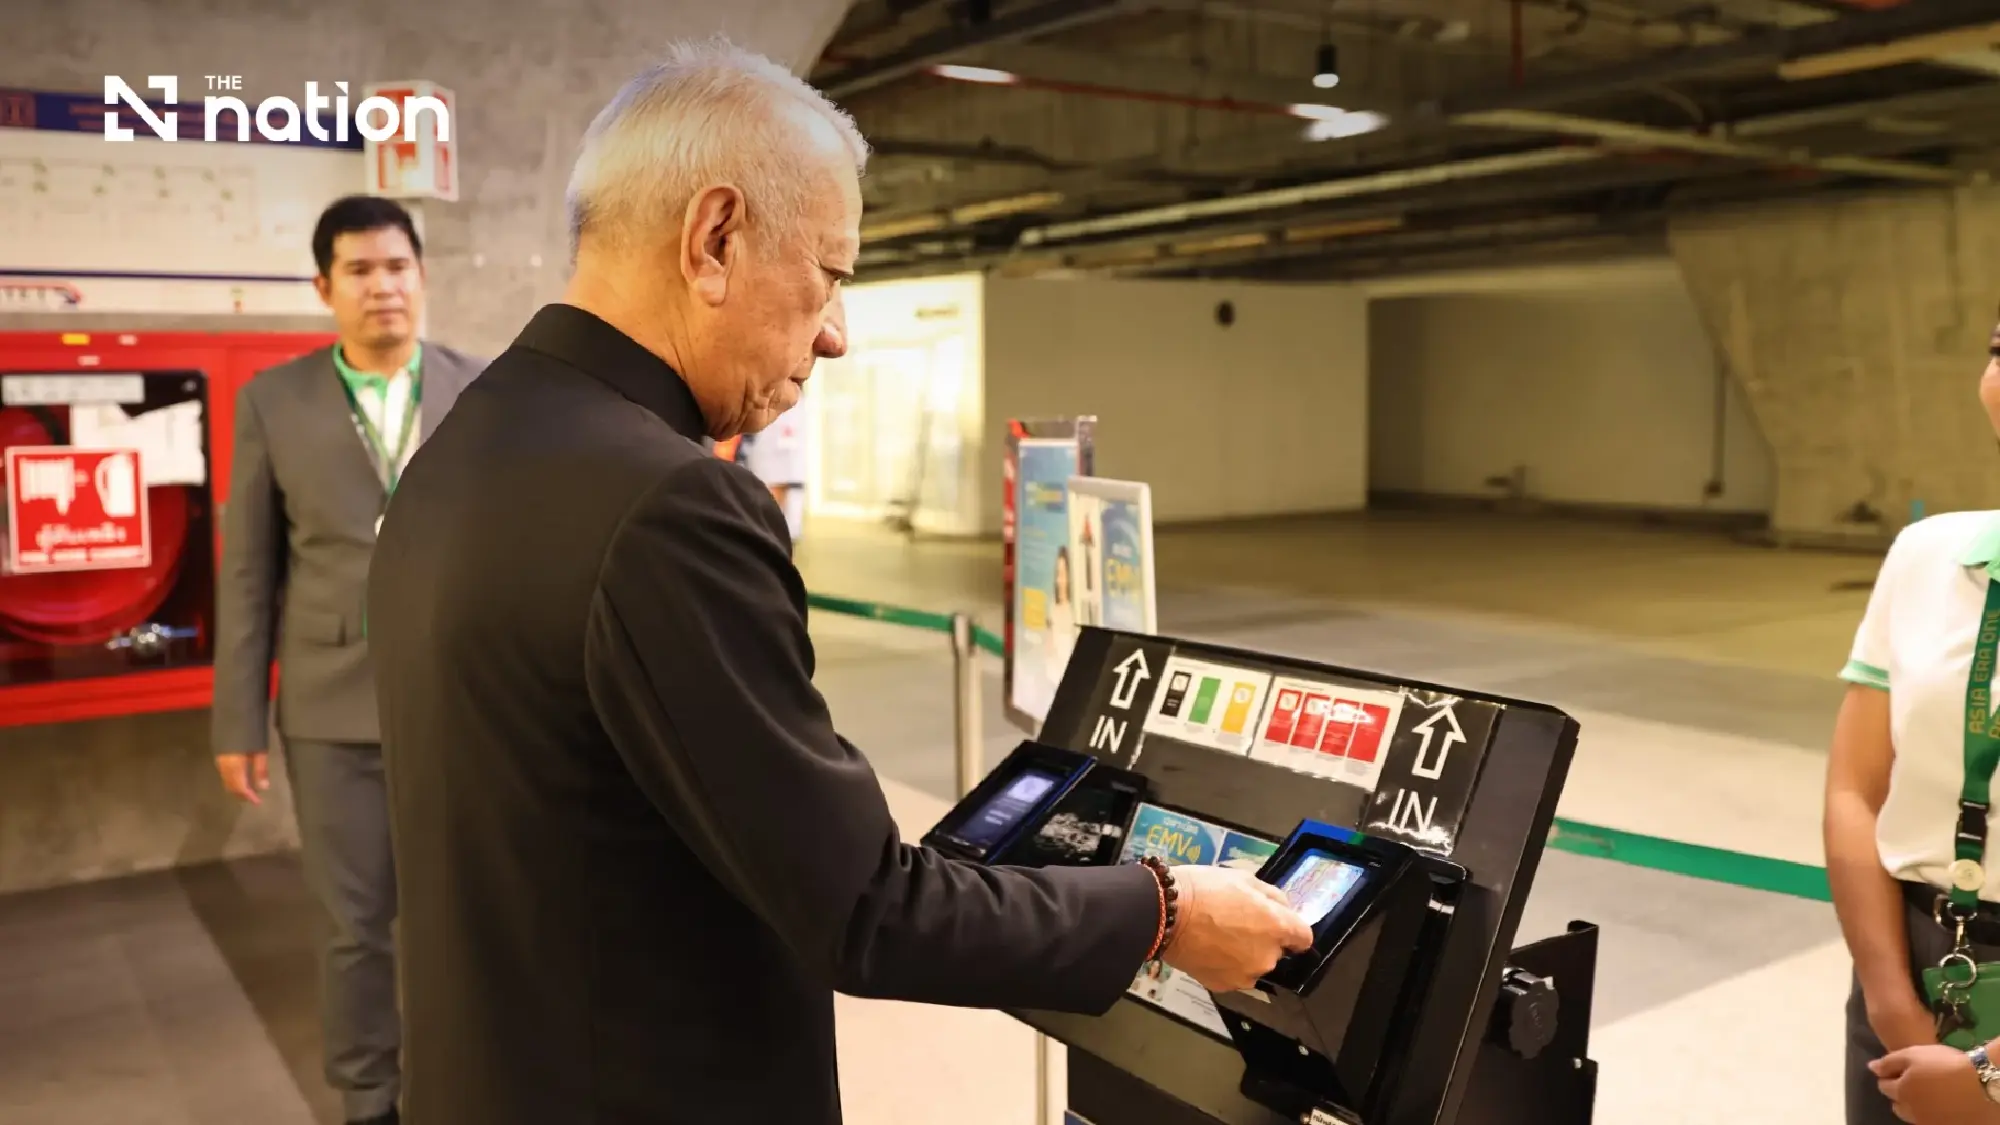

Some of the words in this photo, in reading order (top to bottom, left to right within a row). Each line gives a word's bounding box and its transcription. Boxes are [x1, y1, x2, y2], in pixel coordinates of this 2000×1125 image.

[1974, 648, 1992, 682] ERA
[1969, 688, 1986, 733] ASIA
[1089, 714, 1128, 753] IN
[1388, 788, 1438, 835] IN
[1147, 824, 1192, 856] EMV
